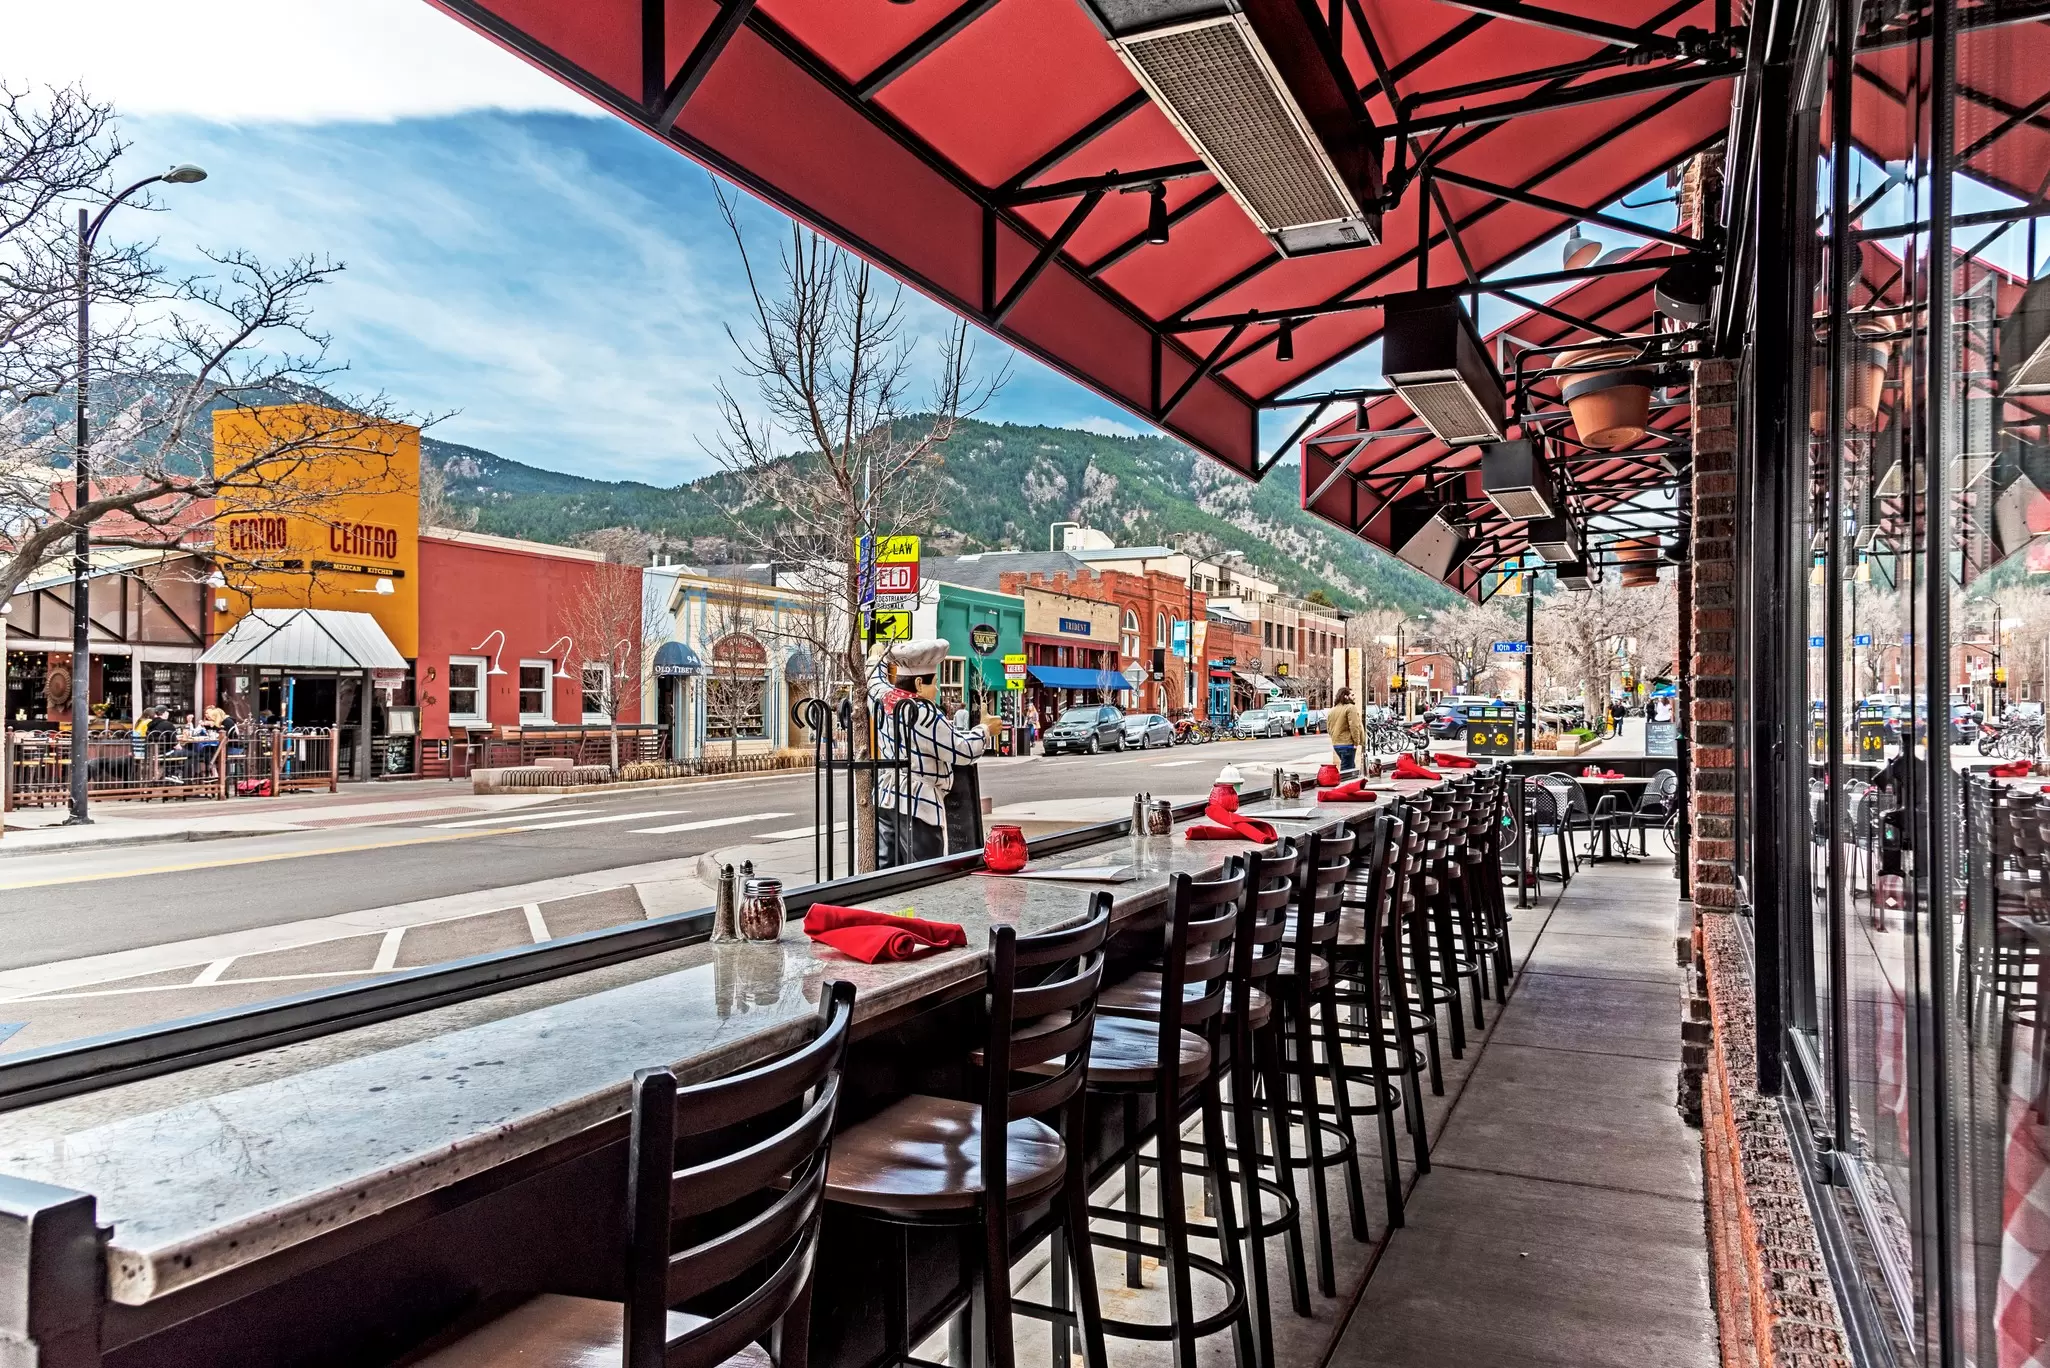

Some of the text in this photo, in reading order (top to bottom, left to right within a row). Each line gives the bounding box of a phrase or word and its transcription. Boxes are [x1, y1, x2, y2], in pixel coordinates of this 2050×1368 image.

[229, 517, 287, 551] CENTRO
[330, 520, 398, 559] CENTRO
[893, 543, 913, 555] LAW
[333, 563, 394, 576] MEXICAN KITCHEN
[879, 568, 908, 588] ELD
[1065, 621, 1087, 632] TRIDENT
[1515, 643, 1523, 651] St
[655, 665, 671, 674] OLD
[672, 665, 693, 674] TIBET
